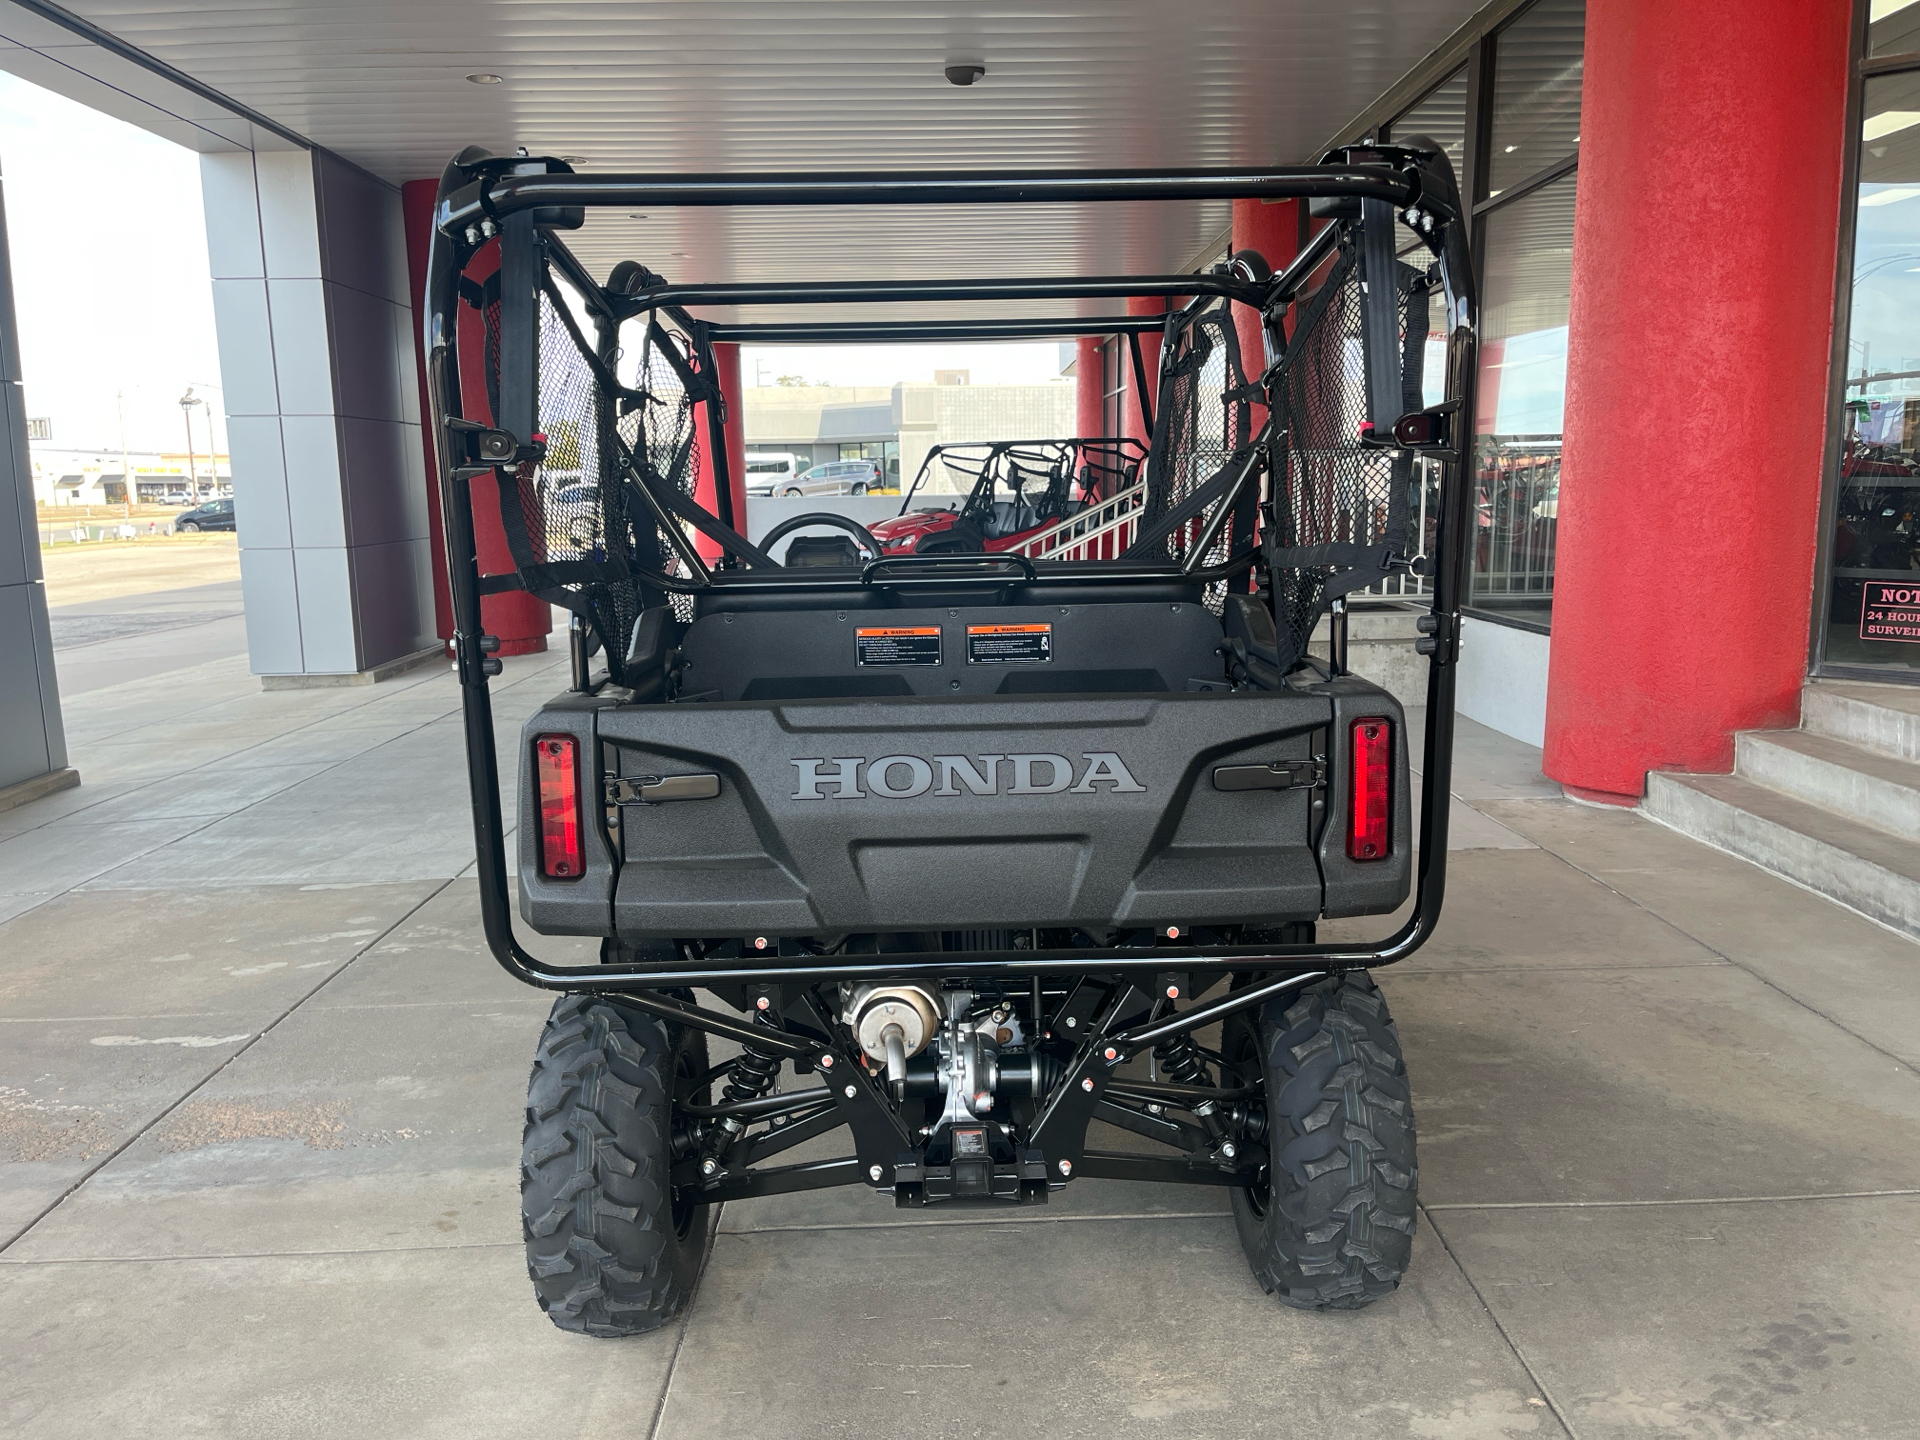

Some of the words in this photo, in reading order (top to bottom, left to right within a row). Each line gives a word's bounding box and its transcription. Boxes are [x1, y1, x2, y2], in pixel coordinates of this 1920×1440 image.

[1881, 589, 1920, 603] NOT
[1867, 610, 1883, 620] 24
[790, 751, 1148, 801] HONDA
